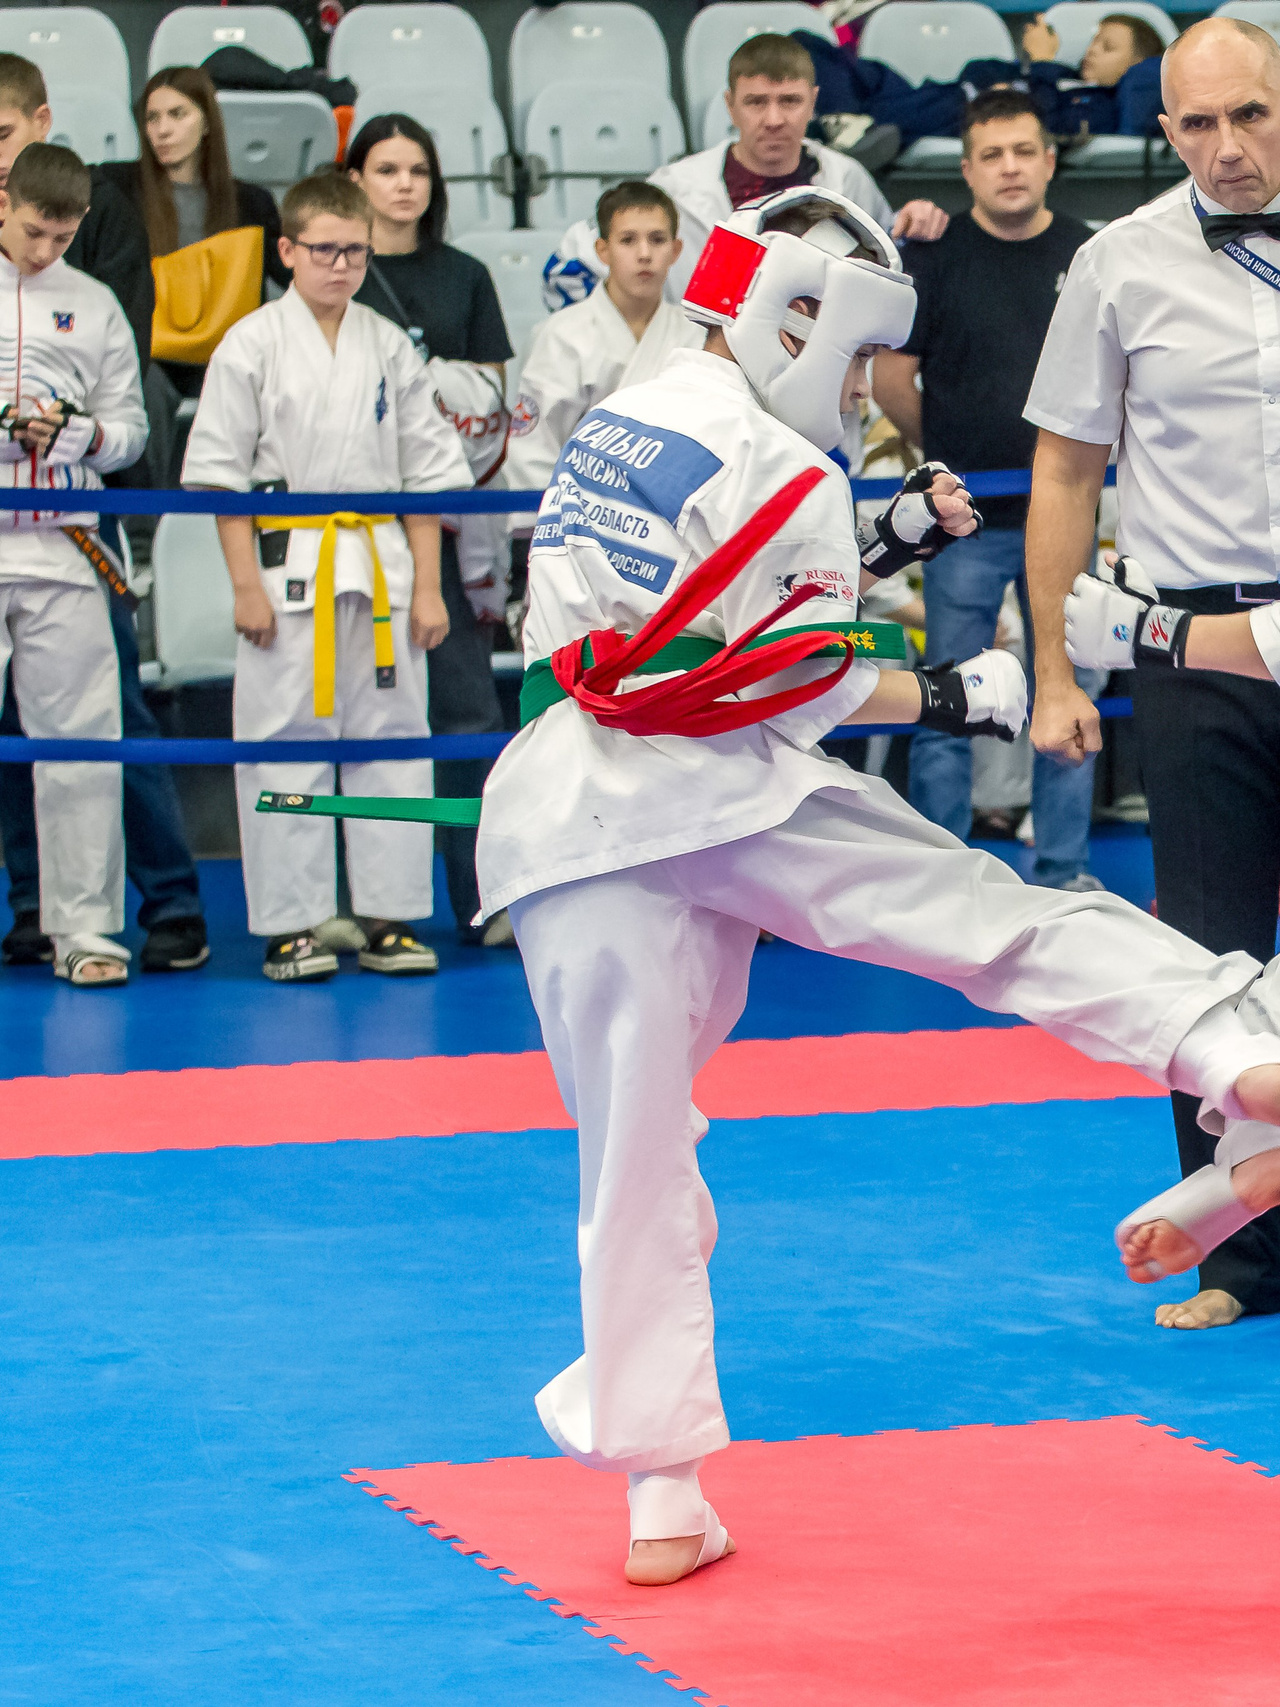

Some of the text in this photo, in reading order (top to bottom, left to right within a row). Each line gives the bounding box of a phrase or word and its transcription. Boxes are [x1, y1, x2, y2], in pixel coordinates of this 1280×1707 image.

[589, 504, 650, 539] ОБЛАСТЬ
[609, 551, 660, 582] РОССИИ
[805, 569, 847, 583] RUSSIA
